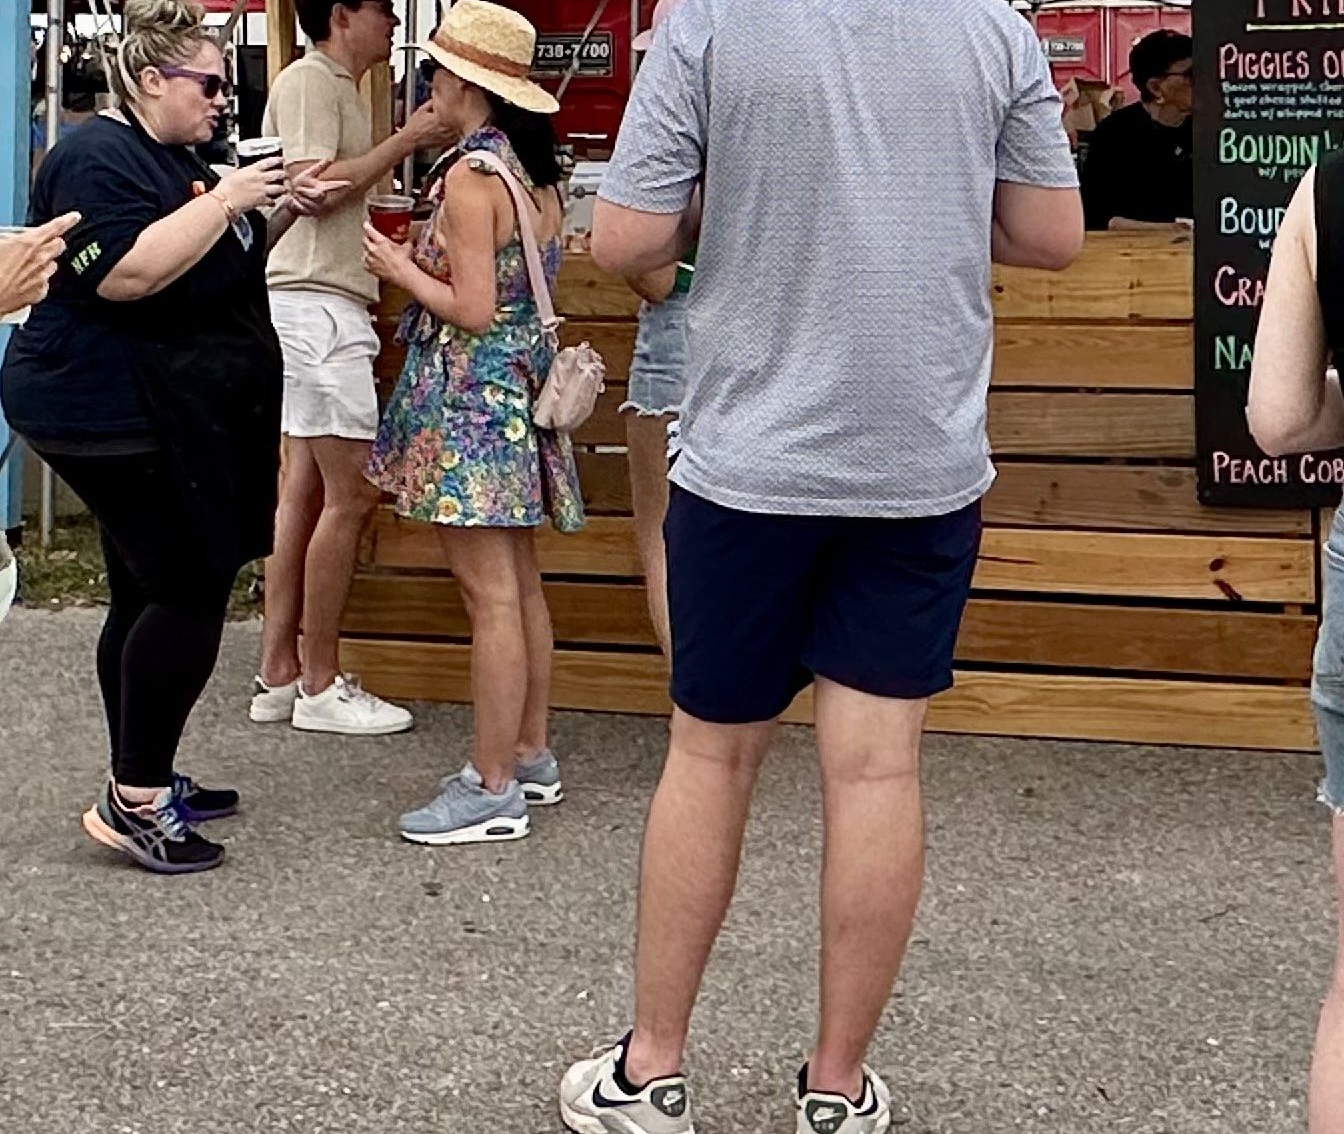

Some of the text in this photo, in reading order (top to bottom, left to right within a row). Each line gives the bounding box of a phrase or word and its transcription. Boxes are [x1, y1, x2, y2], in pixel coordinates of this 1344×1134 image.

[1218, 43, 1311, 81] PIGGIES
[1219, 126, 1320, 166] BOUDIN
[1213, 451, 1287, 486] PEACH
